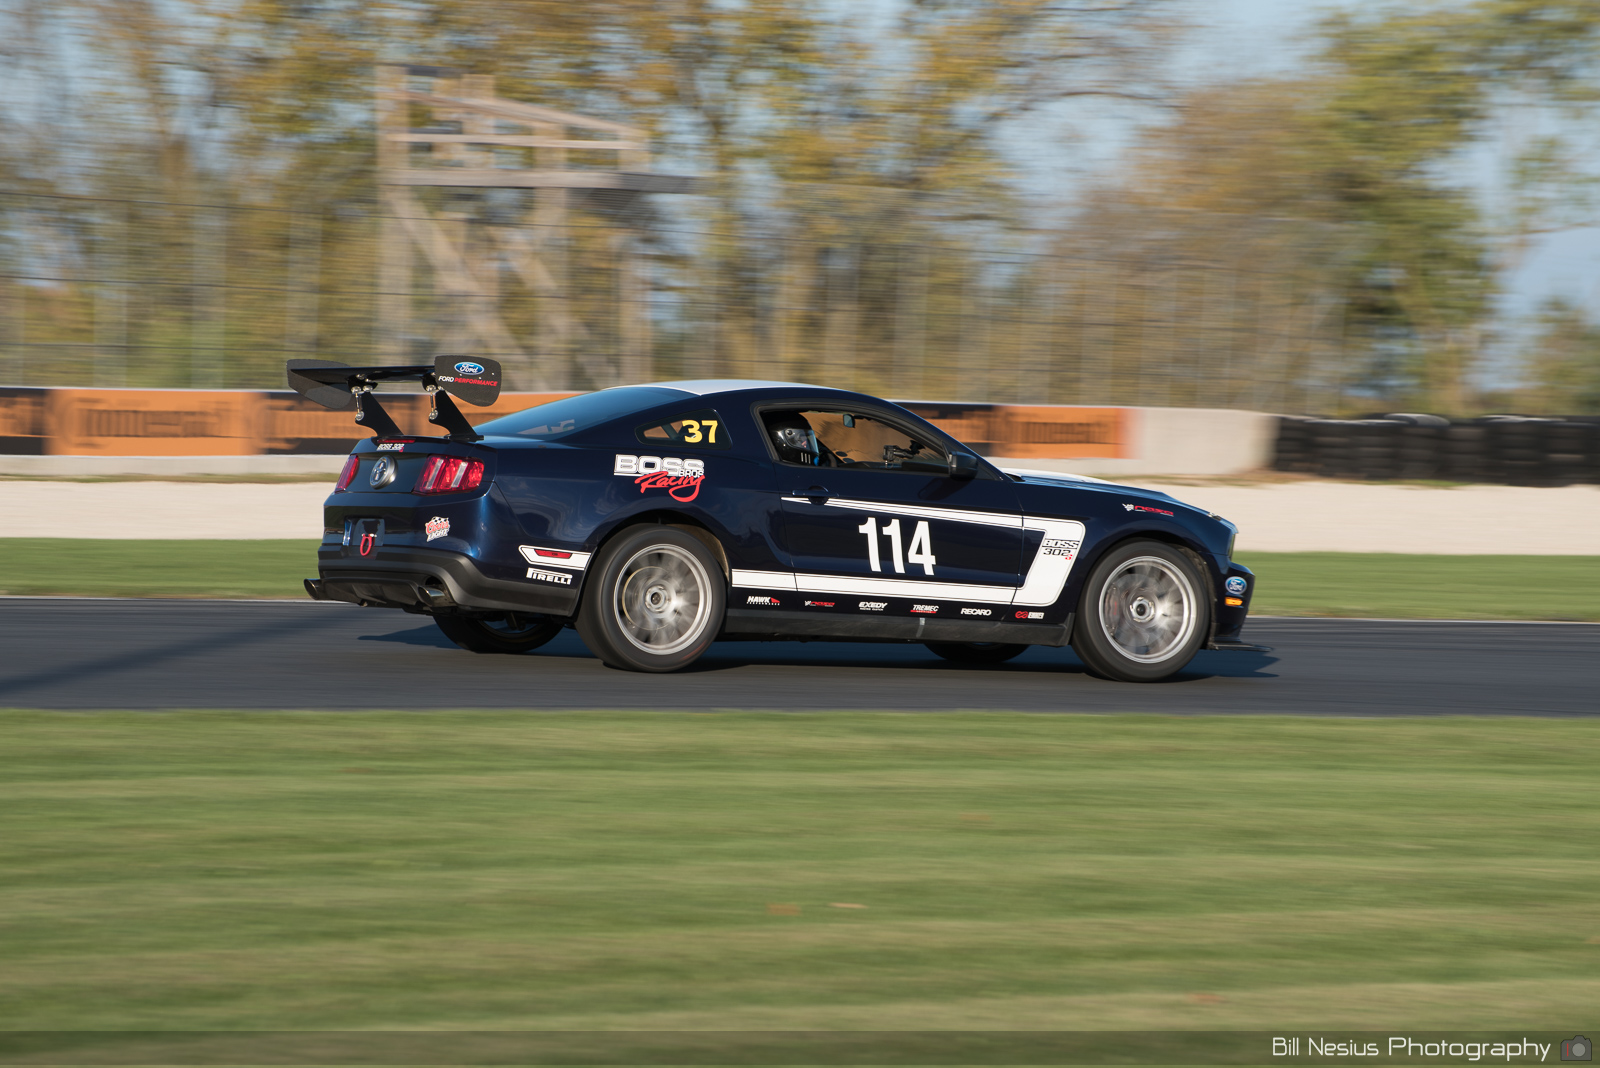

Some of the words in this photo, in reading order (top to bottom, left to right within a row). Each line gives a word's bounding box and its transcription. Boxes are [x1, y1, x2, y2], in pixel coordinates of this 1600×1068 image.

[460, 363, 479, 373] Ford
[438, 375, 454, 383] FORD
[454, 377, 498, 387] PERFORMANCE
[682, 419, 718, 444] 37
[614, 454, 704, 476] BOSS
[634, 471, 706, 503] Racing
[426, 521, 449, 534] Coors
[858, 516, 937, 576] 114
[1042, 538, 1080, 549] BOSS
[526, 567, 573, 585] PIRELLI
[747, 595, 771, 603] HAWK
[858, 601, 888, 609] EXEDY
[912, 604, 939, 612] TREMEC
[960, 606, 992, 616] RECARO
